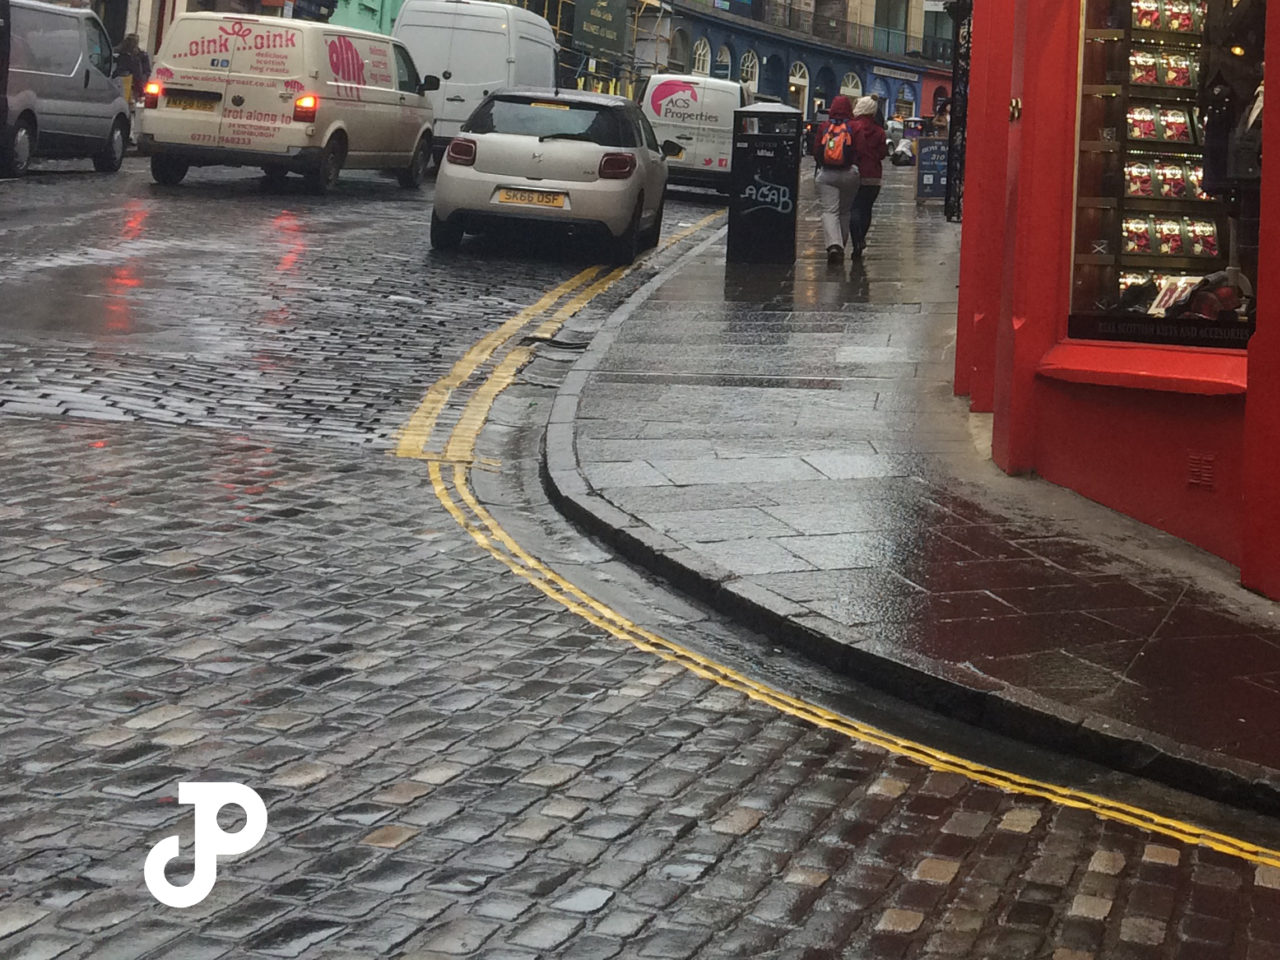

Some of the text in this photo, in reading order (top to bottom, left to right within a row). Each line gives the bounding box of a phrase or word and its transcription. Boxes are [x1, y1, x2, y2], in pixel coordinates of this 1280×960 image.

[666, 97, 690, 109] ACS
[223, 107, 292, 125] trot along to
[664, 108, 719, 122] Properties
[504, 190, 534, 201] SK66
